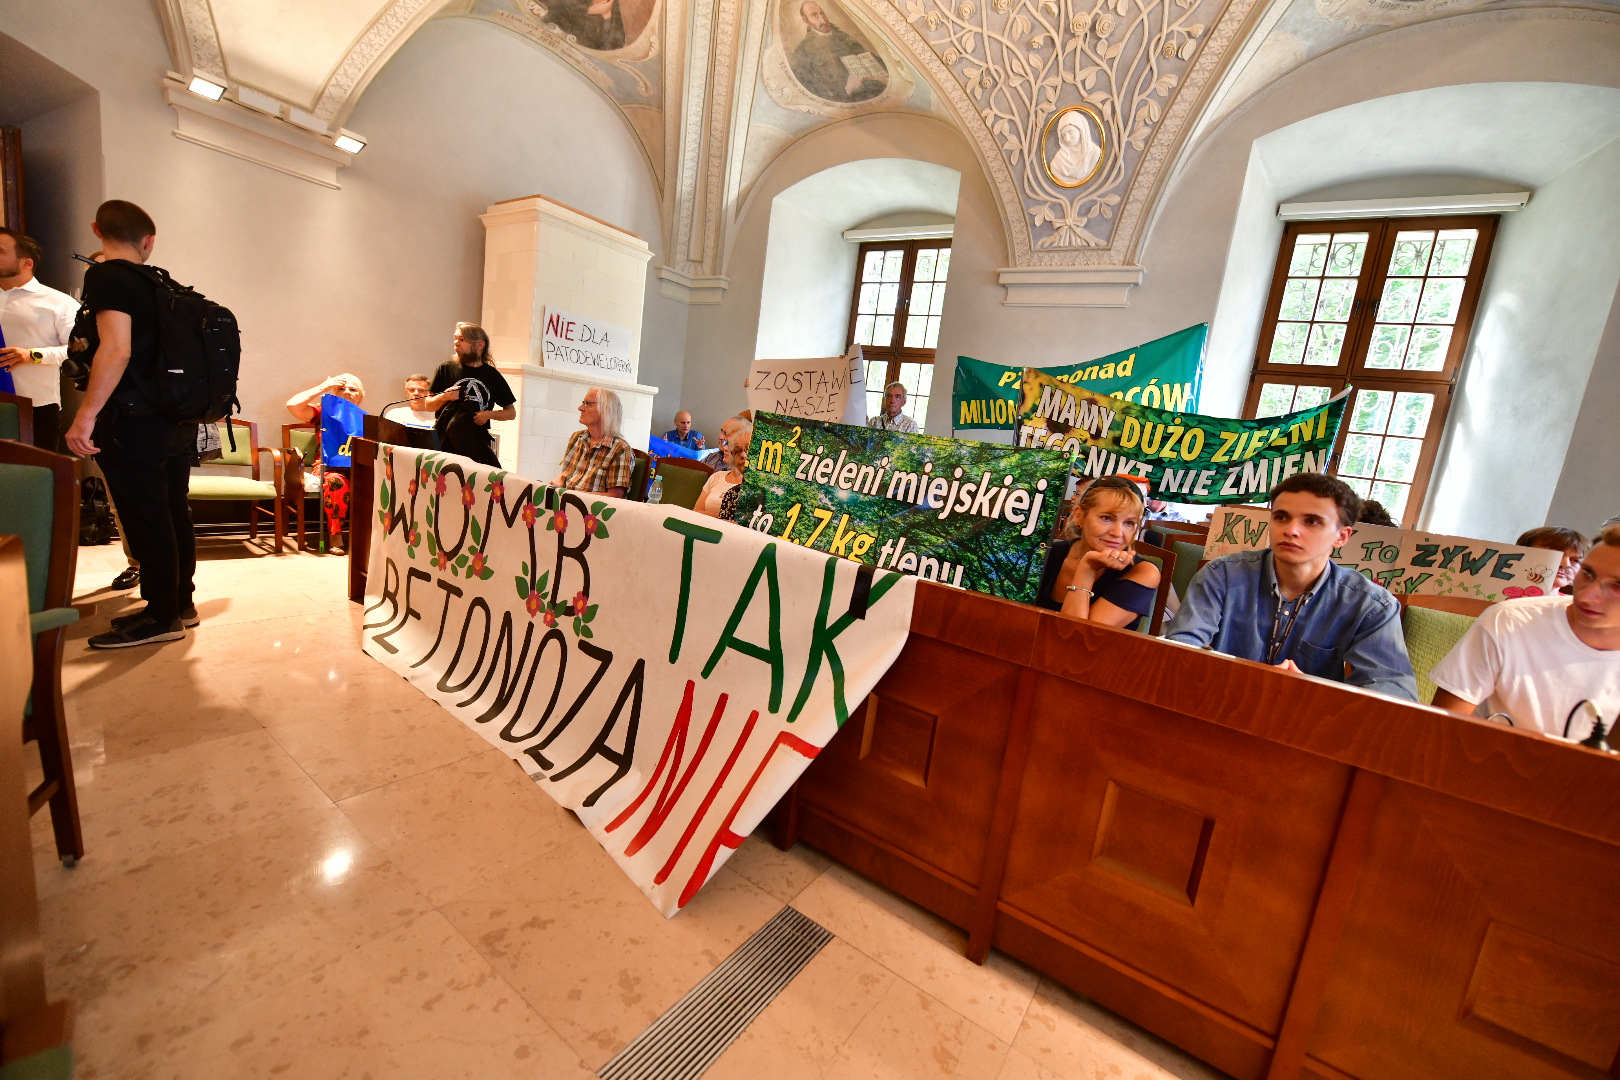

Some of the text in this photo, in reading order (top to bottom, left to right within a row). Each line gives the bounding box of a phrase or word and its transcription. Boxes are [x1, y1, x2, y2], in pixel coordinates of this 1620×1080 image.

[578, 324, 610, 347] DLA
[1035, 385, 1116, 440] MAMY
[1119, 417, 1205, 462] DUŻO
[794, 445, 890, 496] zieleni
[885, 462, 1049, 537] miejskiej
[1158, 467, 1217, 496] NIE
[749, 503, 774, 534] to
[829, 513, 876, 564] kg
[1361, 541, 1400, 564] TO
[1410, 537, 1526, 581] ŻYWE
[663, 515, 902, 730] TAK
[362, 556, 646, 808] BETONOZA
